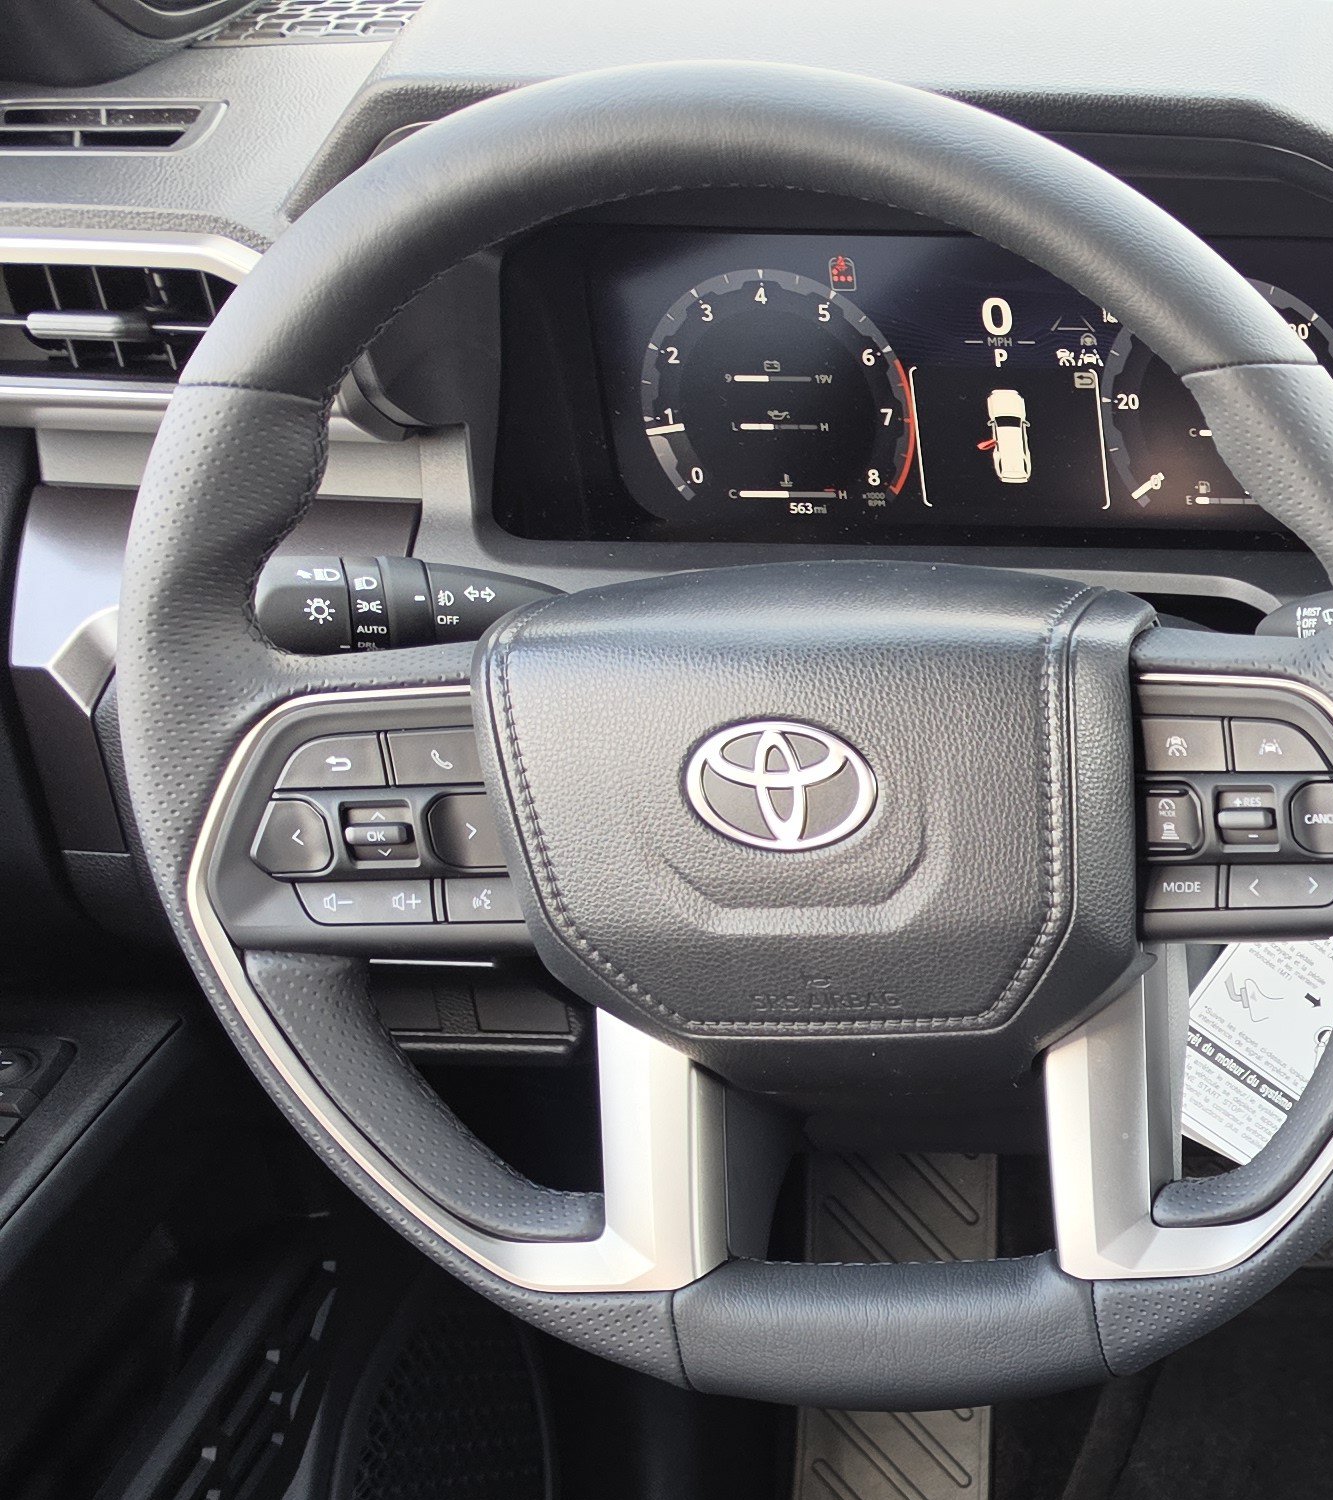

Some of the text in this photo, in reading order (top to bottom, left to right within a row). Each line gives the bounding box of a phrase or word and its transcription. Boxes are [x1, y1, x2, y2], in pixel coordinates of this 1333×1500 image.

[754, 287, 767, 305] 4
[700, 304, 714, 321] 3
[818, 304, 830, 321] 5
[982, 297, 1013, 335] 0
[987, 337, 1013, 347] MPH
[667, 348, 680, 364] 2
[862, 349, 875, 366] 6
[995, 350, 1008, 367] P
[725, 374, 732, 383] 9
[815, 375, 832, 384] 19V
[1116, 393, 1139, 410] 20
[664, 408, 674, 424] 1
[880, 409, 893, 426] 7
[732, 422, 738, 431] L
[820, 422, 829, 432] H
[1189, 429, 1197, 438] C
[691, 468, 703, 483] 0
[868, 470, 880, 485] 8
[729, 489, 737, 498] C
[839, 490, 847, 499] H
[1186, 496, 1193, 505] E
[438, 615, 459, 625] OFF
[1302, 618, 1317, 628] OFF
[357, 626, 387, 634] AUTO
[367, 831, 385, 842] OK
[1163, 881, 1201, 893] MODE
[754, 993, 902, 1012] SRS AIRBAG
[1202, 1043, 1215, 1056] du
[1260, 1084, 1292, 1110] système
